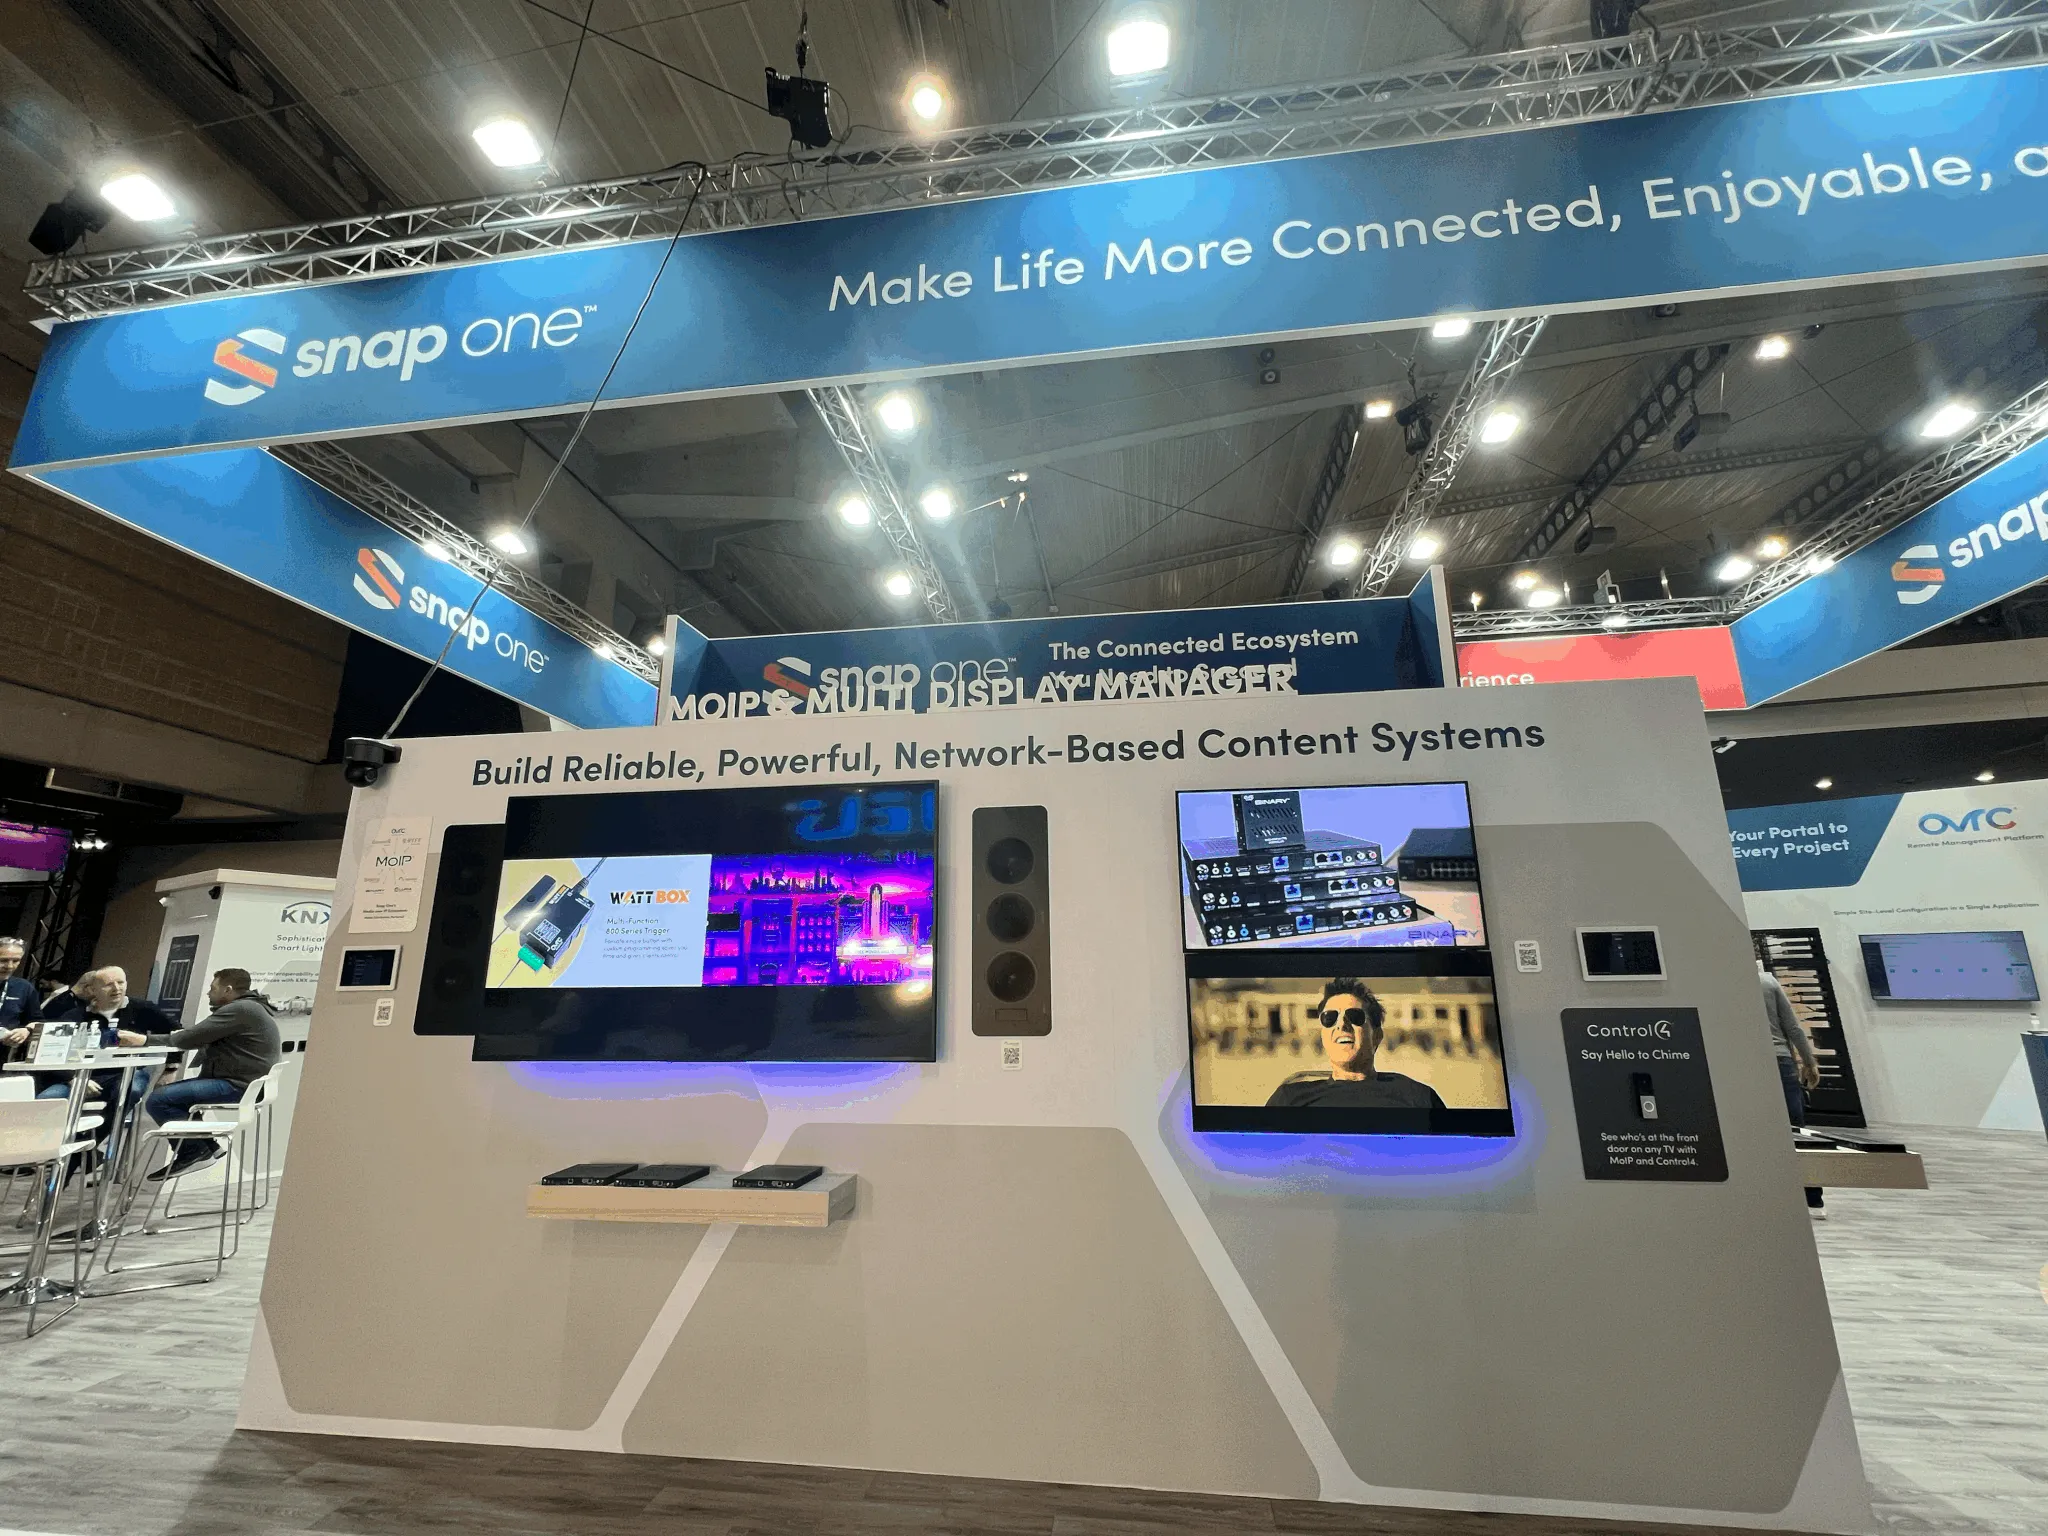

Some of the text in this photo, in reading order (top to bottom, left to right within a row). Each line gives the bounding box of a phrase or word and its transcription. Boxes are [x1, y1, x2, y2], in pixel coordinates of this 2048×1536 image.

[828, 264, 973, 311] Make
[993, 248, 1085, 293] Life
[1104, 237, 1253, 281] More
[1272, 186, 1622, 260] Connected,
[1642, 146, 1994, 224] Enjoyable,
[292, 323, 449, 381] snap
[409, 585, 490, 651] snap
[1048, 628, 1359, 662] The Connected Ecosystem
[819, 663, 922, 694] snap
[669, 664, 1298, 721] MOIP & MULTI DISPLAY MANAGER
[472, 722, 1545, 786] Build Reliable, Powerful, Network-Based Content Systems
[1769, 823, 1825, 839] Portal
[1828, 821, 1849, 834] to
[1732, 839, 1851, 860] Every Project
[1941, 837, 2002, 849] Management
[2003, 833, 2045, 843] Platform
[1896, 906, 1949, 914] Configuration
[1966, 903, 1991, 911] Single
[1992, 902, 2040, 910] Application
[606, 917, 659, 925] Multi-Function
[605, 926, 670, 936] 800 Series Trigger
[1581, 1049, 1691, 1062] Say Hello to Chime
[1600, 1132, 1699, 1142] See who's at the front
[1607, 1144, 1628, 1153] door
[1645, 1146, 1662, 1155] any
[1663, 1145, 1675, 1154] TV
[1676, 1145, 1697, 1154] with
[1609, 1156, 1634, 1164] MoIP
[1636, 1156, 1654, 1165] and
